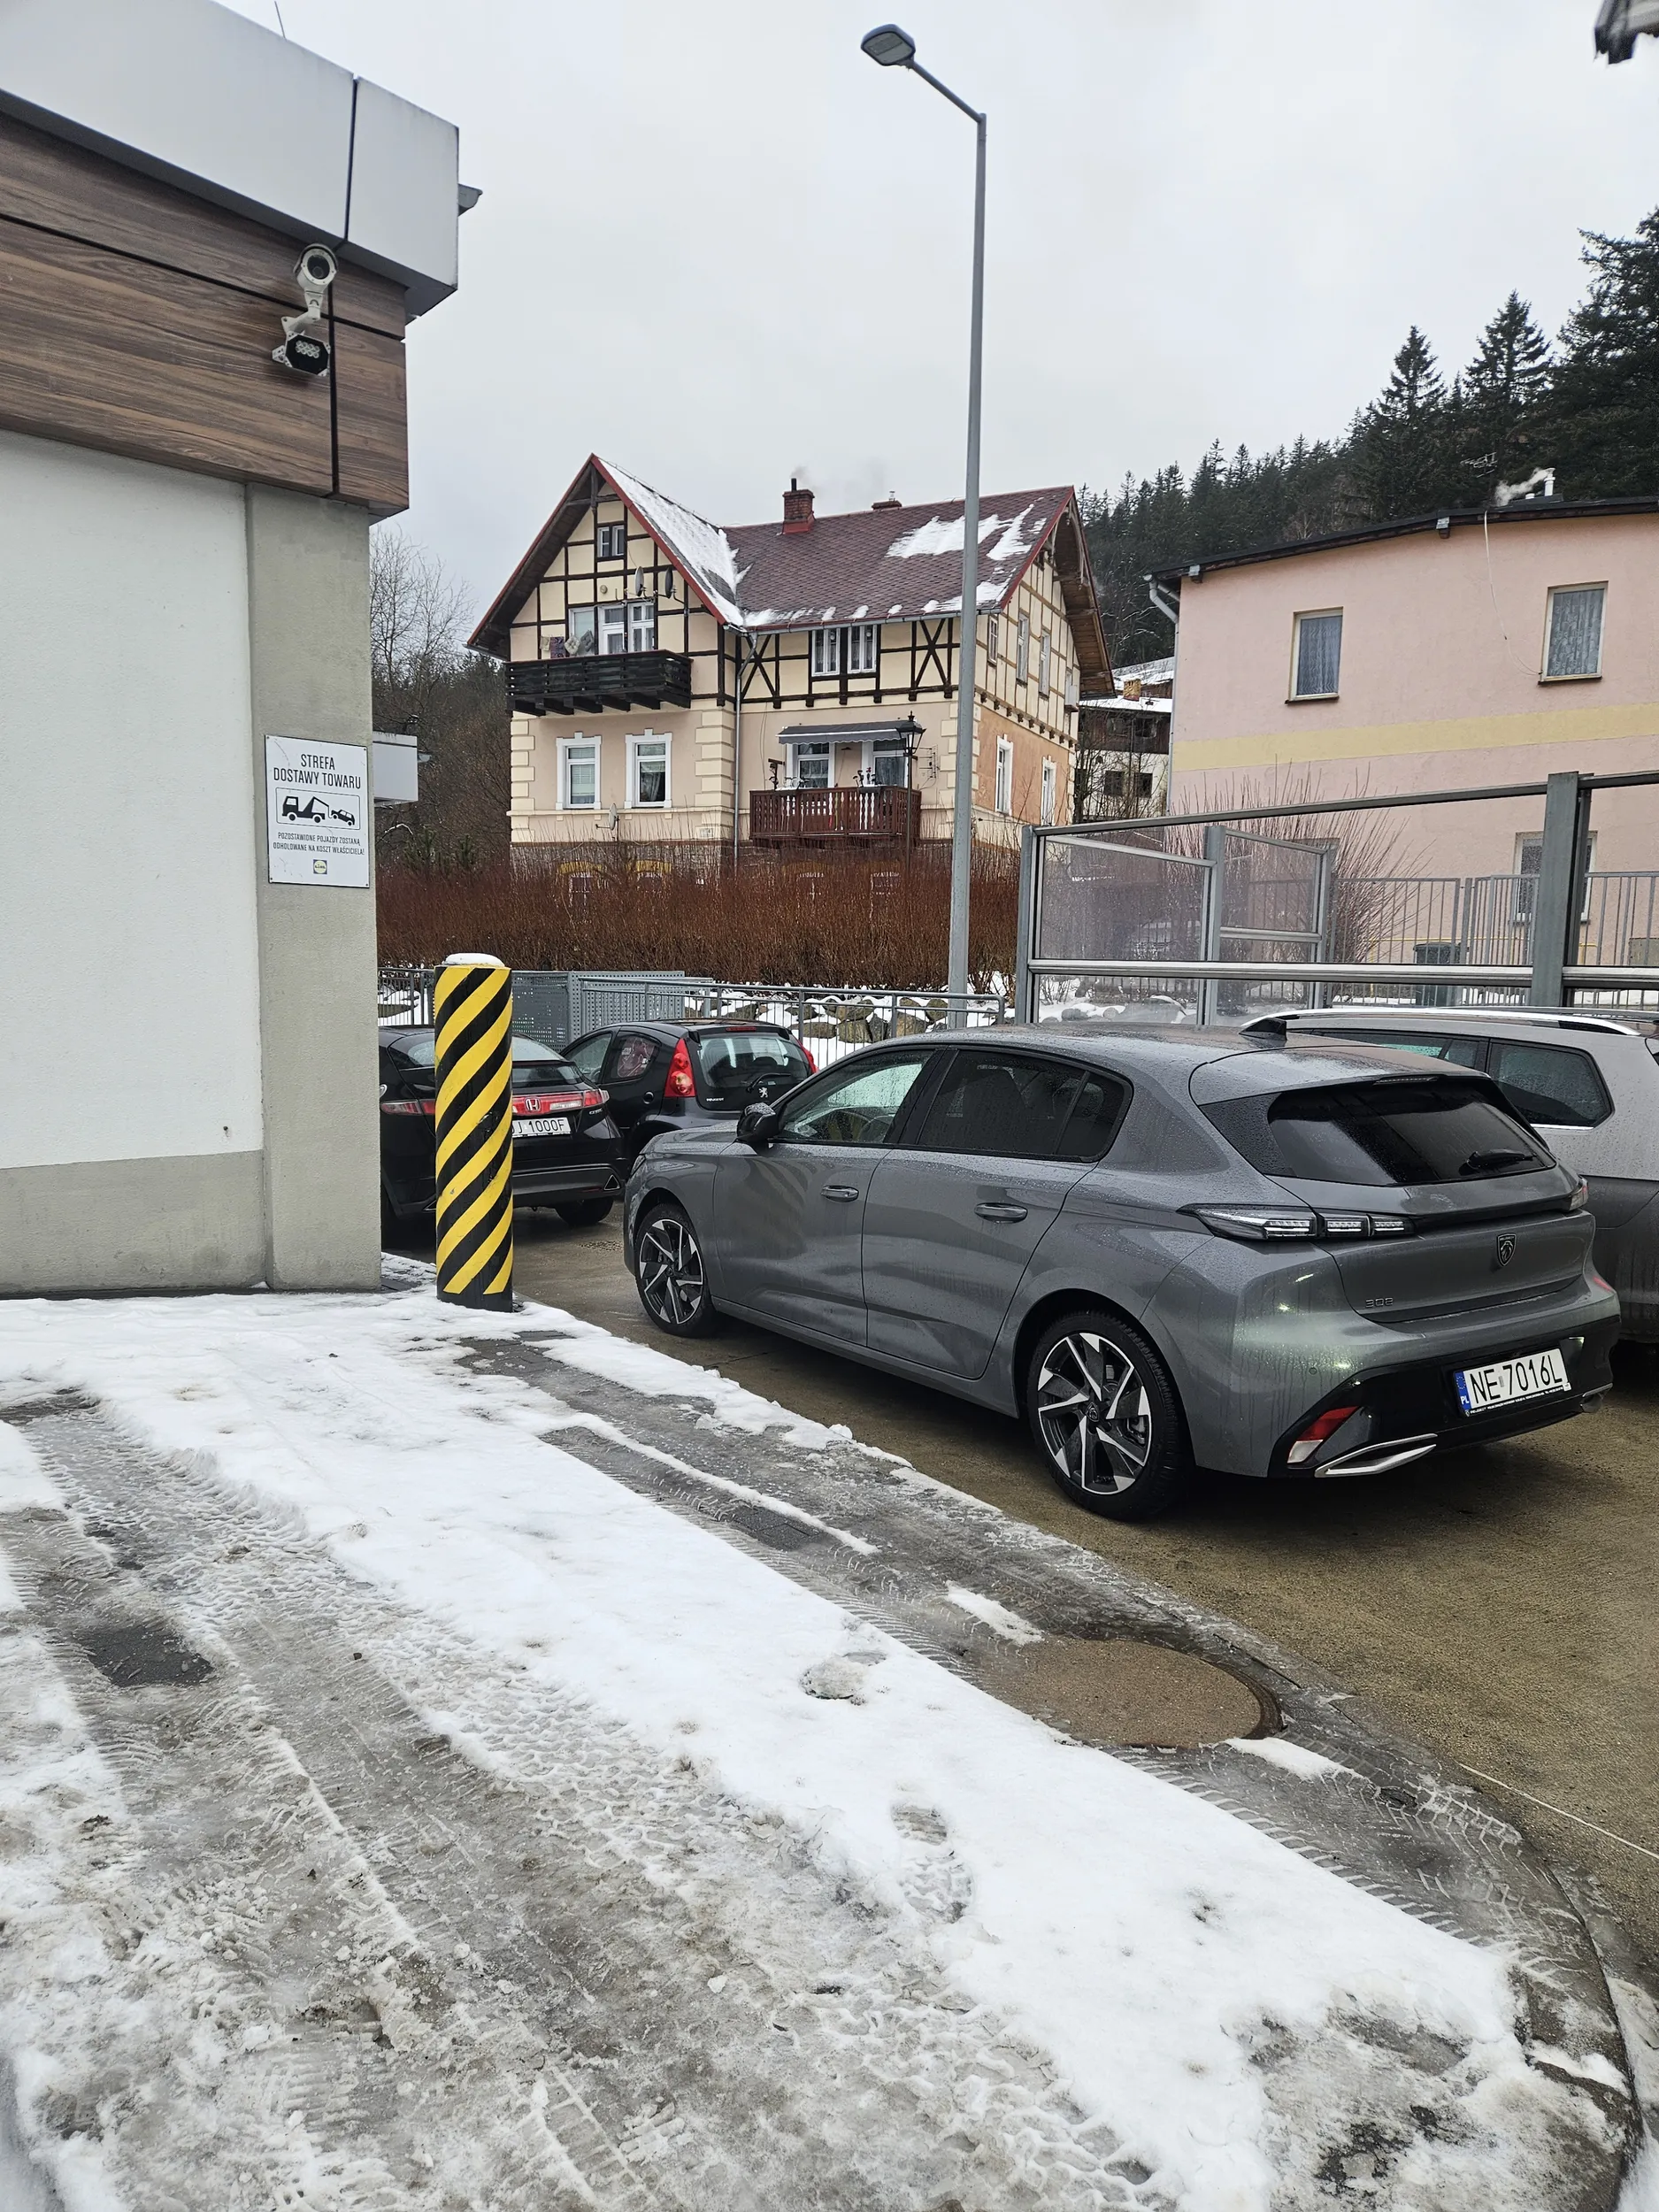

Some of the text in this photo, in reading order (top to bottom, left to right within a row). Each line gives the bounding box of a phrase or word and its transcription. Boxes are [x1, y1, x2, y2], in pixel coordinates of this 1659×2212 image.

[301, 753, 335, 771] STREFA
[273, 767, 361, 789] DOSTAWY TOWARU
[277, 832, 316, 841] POZOSTAWIONE
[317, 834, 339, 844] POJAZDY
[273, 841, 307, 851] ODHOLOWANE
[528, 1119, 565, 1133] 1000F
[1470, 1369, 1501, 1404] NE
[1502, 1355, 1563, 1395] 7016L
[1460, 1395, 1470, 1405] PL
